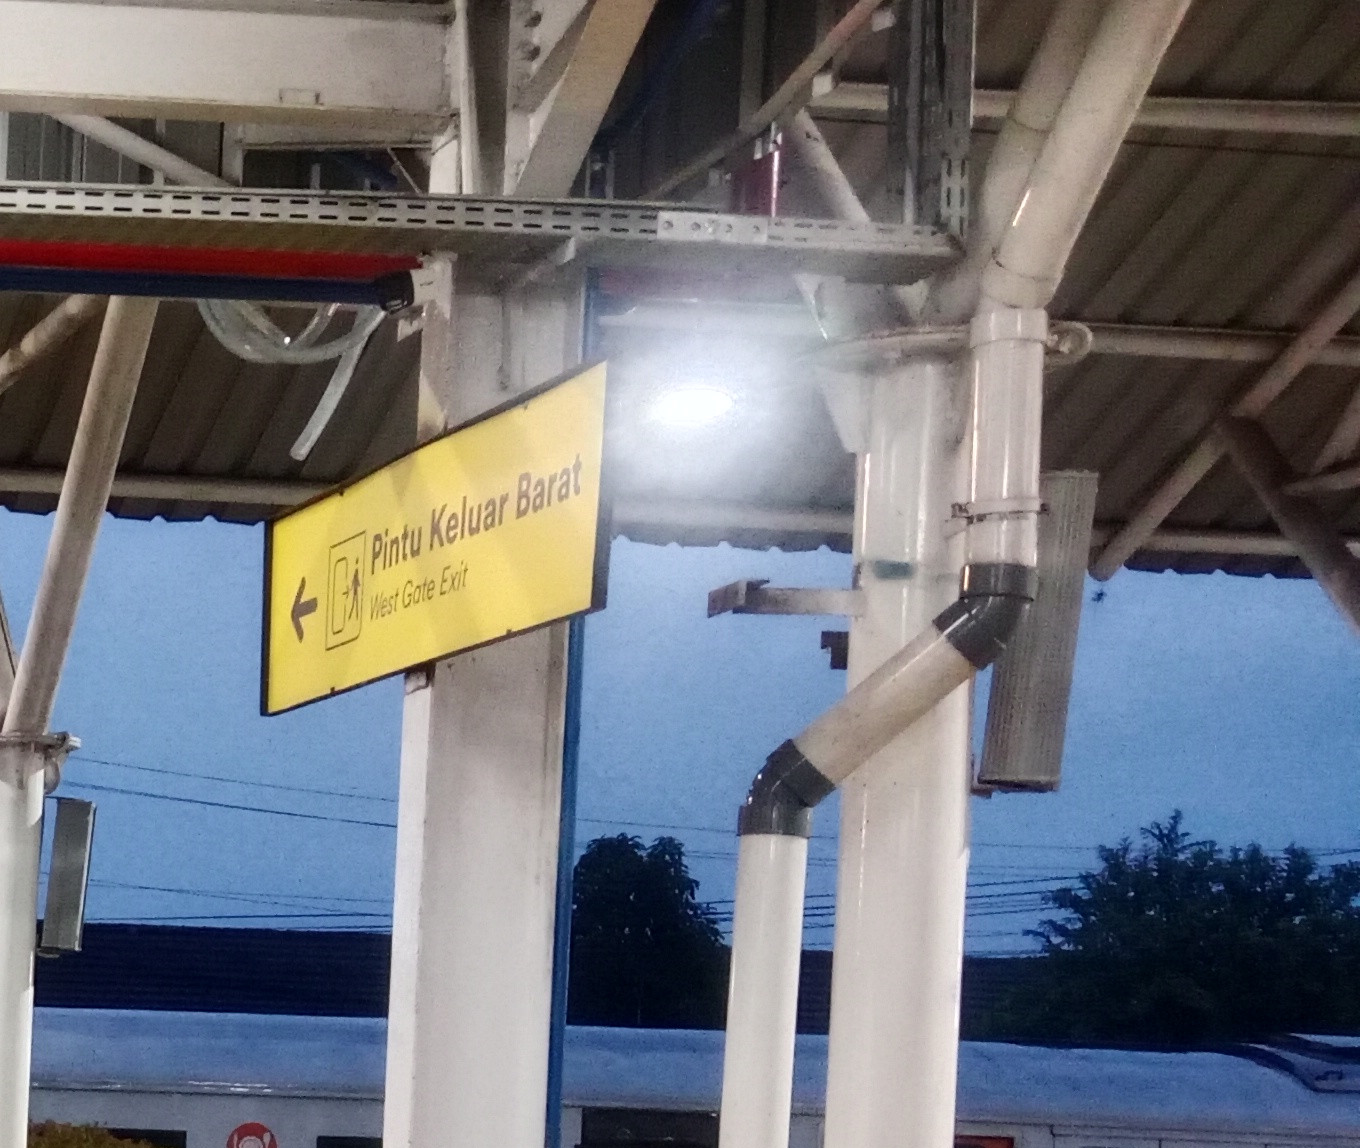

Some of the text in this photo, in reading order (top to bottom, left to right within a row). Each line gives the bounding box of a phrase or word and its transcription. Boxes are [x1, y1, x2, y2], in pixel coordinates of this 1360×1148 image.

[371, 453, 582, 575] Pintu Keluar Barat
[370, 560, 469, 620] West Gate Exit
